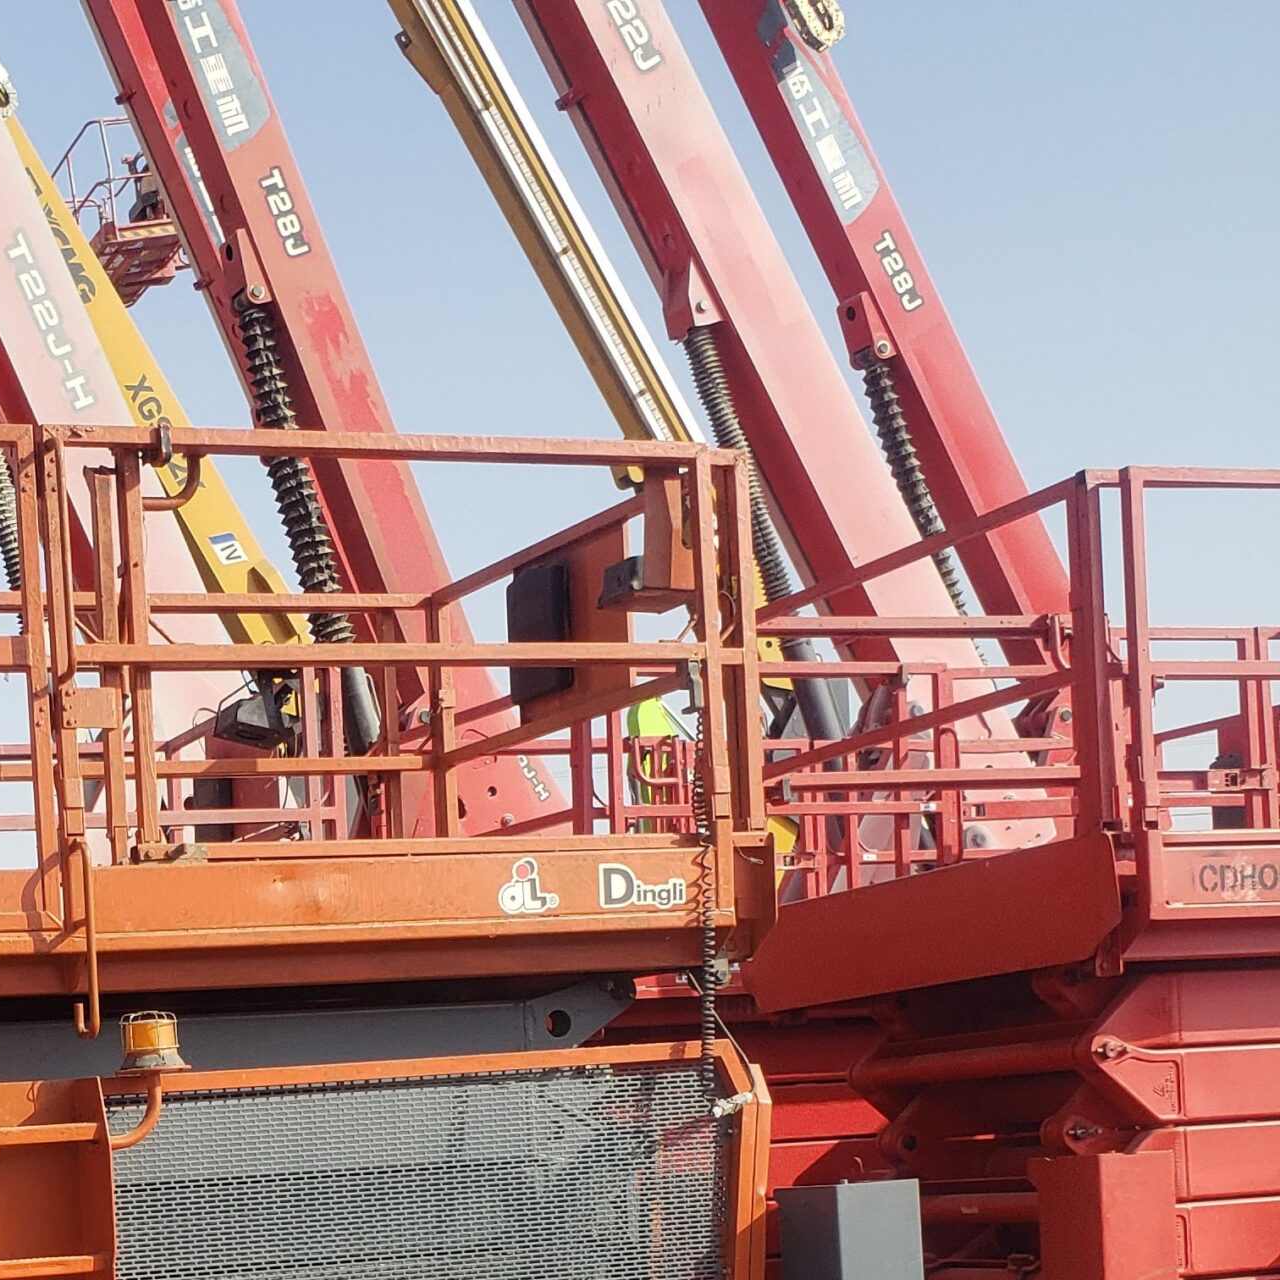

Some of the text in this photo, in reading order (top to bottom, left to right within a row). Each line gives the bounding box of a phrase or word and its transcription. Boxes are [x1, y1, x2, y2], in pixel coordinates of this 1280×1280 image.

[178, 0, 250, 137] 工重机
[260, 168, 310, 256] T28J
[875, 231, 923, 311] T28J
[8, 231, 96, 411] T22J-H
[602, 867, 684, 906] Dingli
